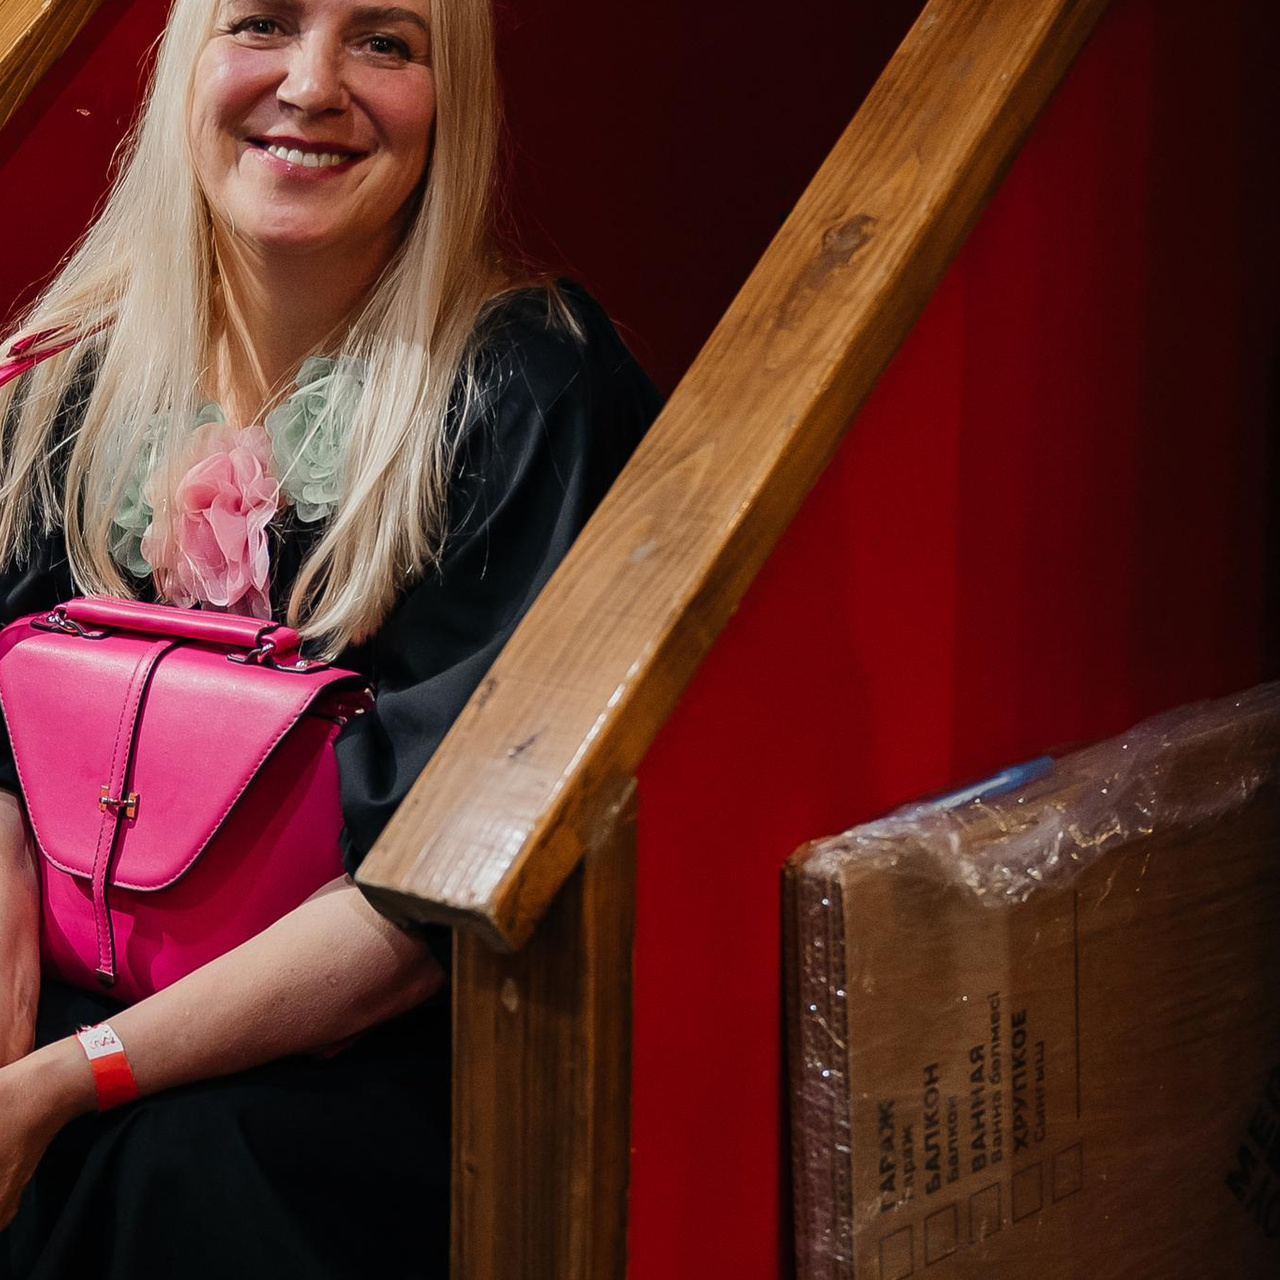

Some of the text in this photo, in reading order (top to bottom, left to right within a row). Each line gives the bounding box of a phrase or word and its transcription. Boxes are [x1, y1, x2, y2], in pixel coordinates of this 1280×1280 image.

[924, 1063, 942, 1194] БАЛКОН
[968, 1044, 986, 1173] ВАННАЯ
[1010, 1009, 1029, 1152] ХРУПКОЕ
